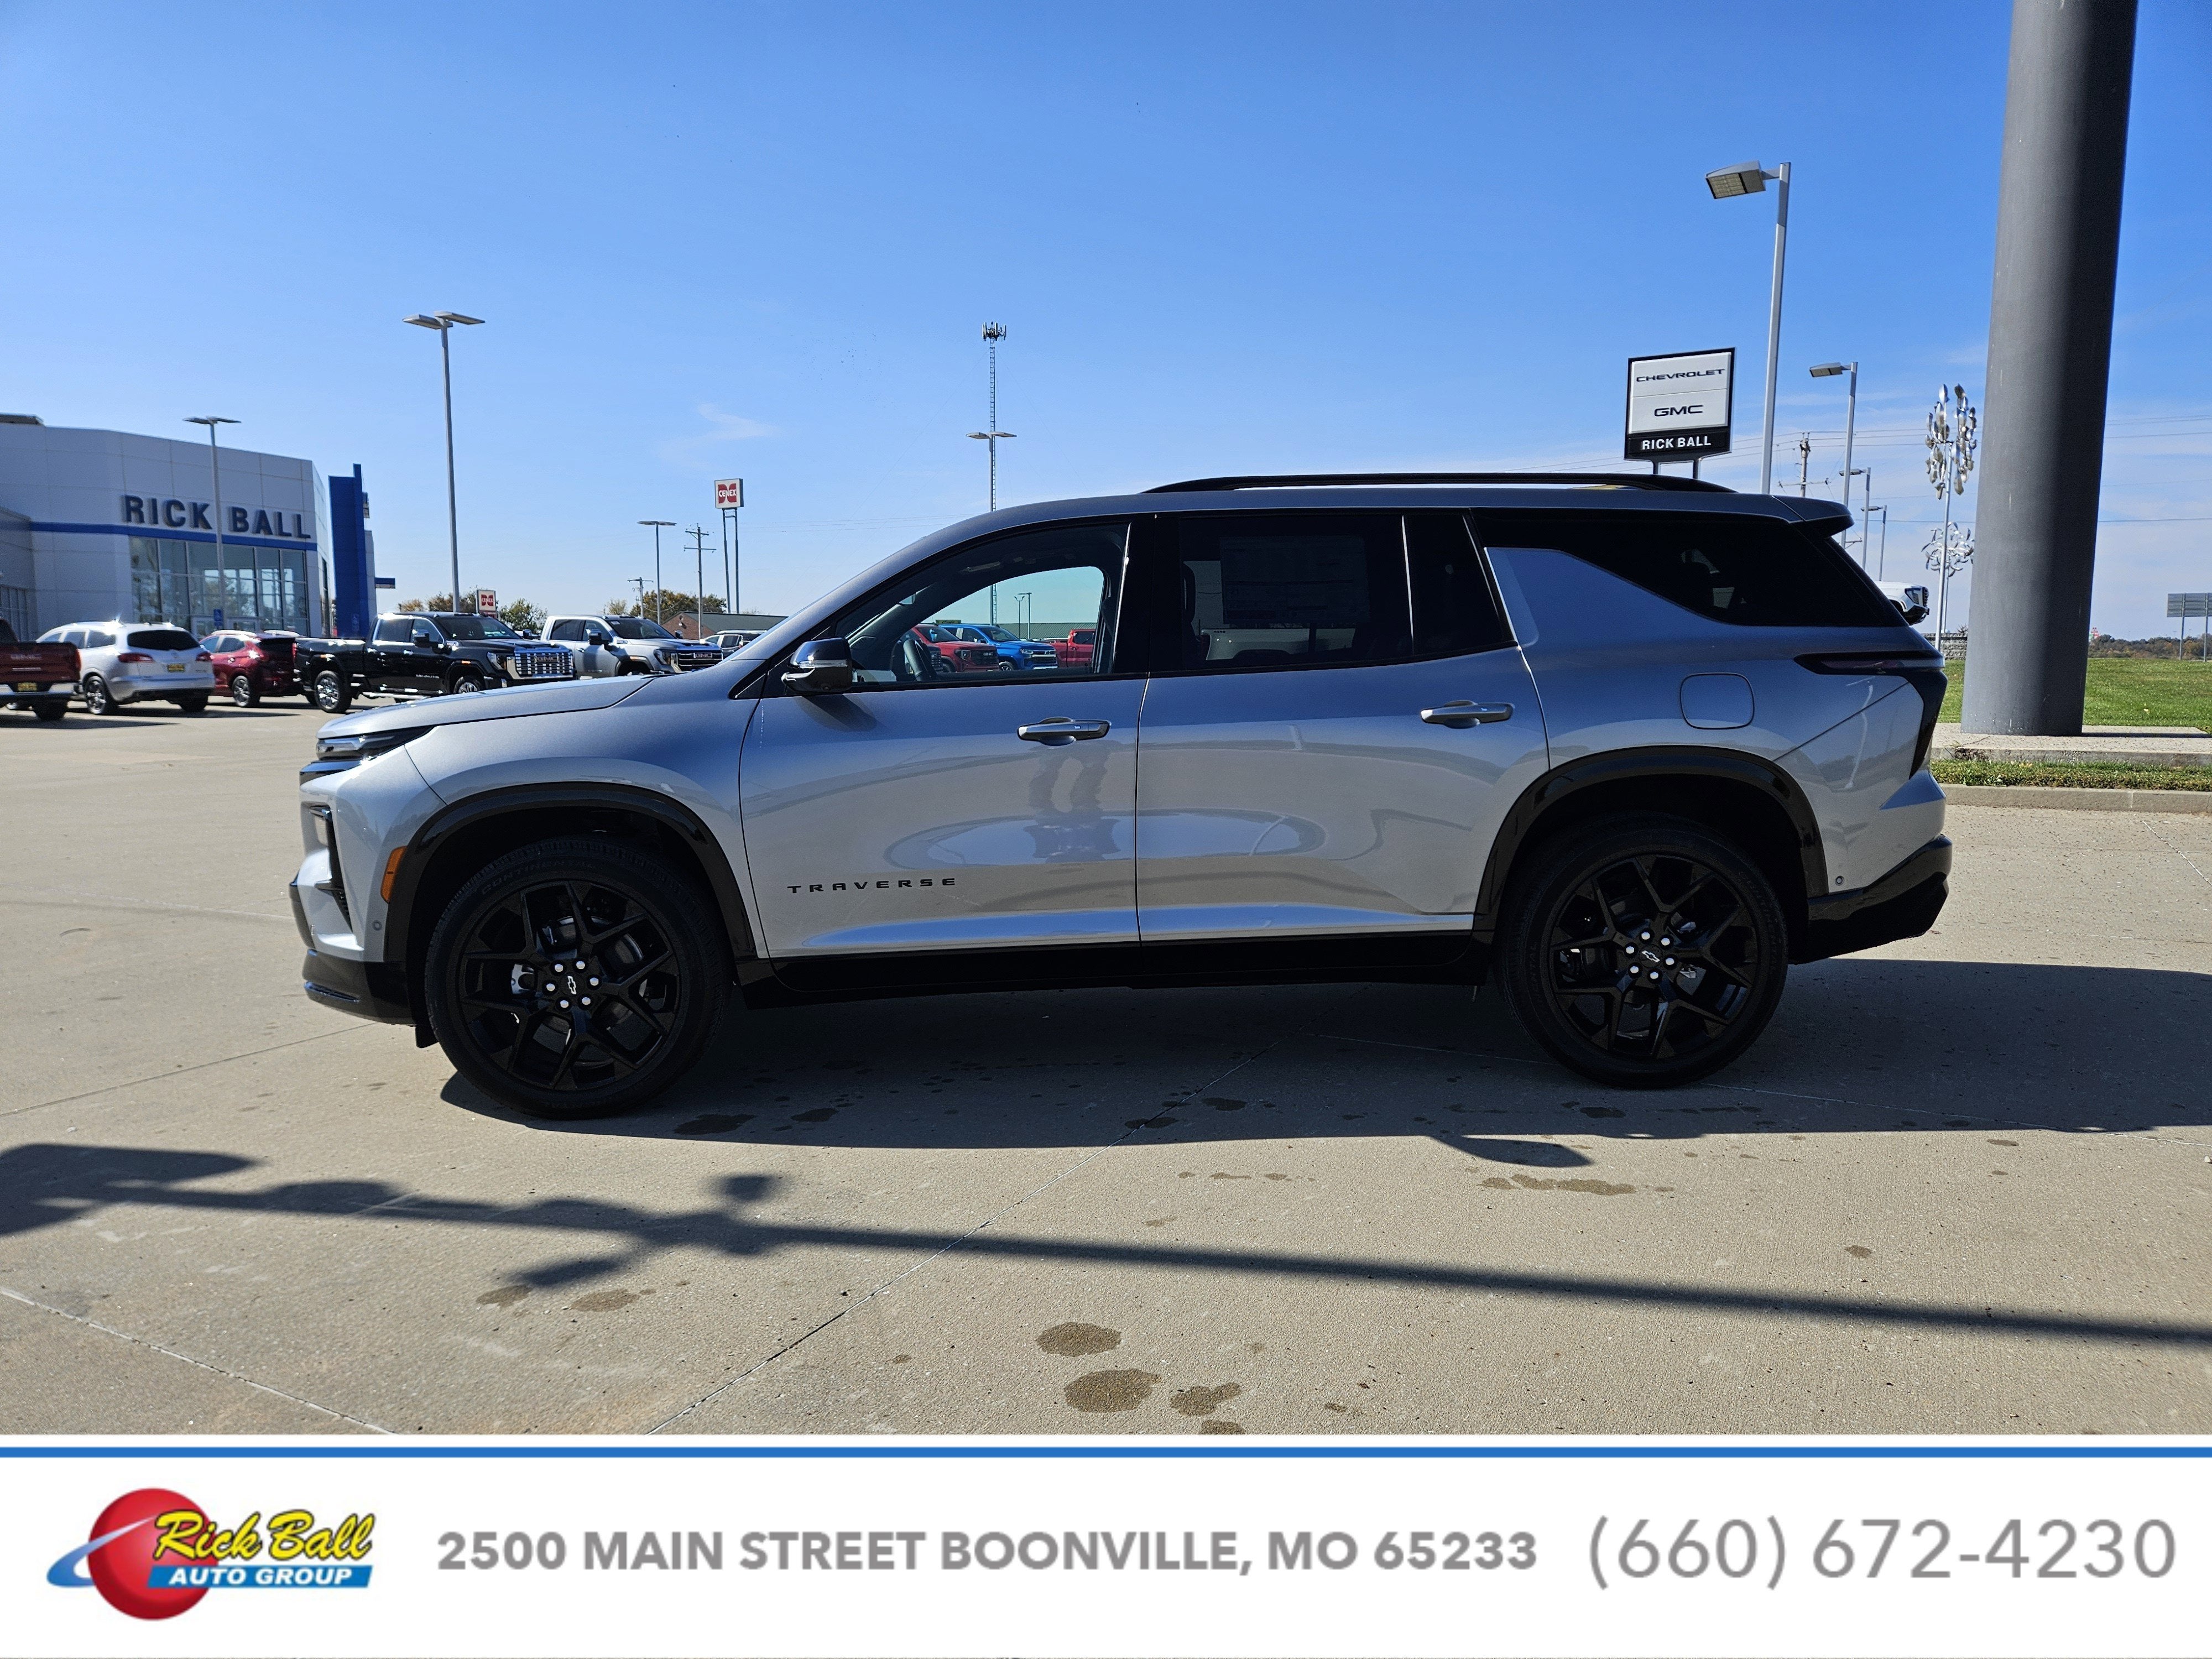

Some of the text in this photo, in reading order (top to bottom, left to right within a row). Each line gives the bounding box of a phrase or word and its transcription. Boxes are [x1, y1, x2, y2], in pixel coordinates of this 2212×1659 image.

[1636, 368, 1725, 382] CHEVROLET
[1654, 405, 1704, 417] GMC
[1641, 435, 1712, 450] RICK BALL
[718, 489, 737, 497] CENEX
[122, 494, 311, 539] RICK BALL
[787, 878, 956, 894] TRAVERSE
